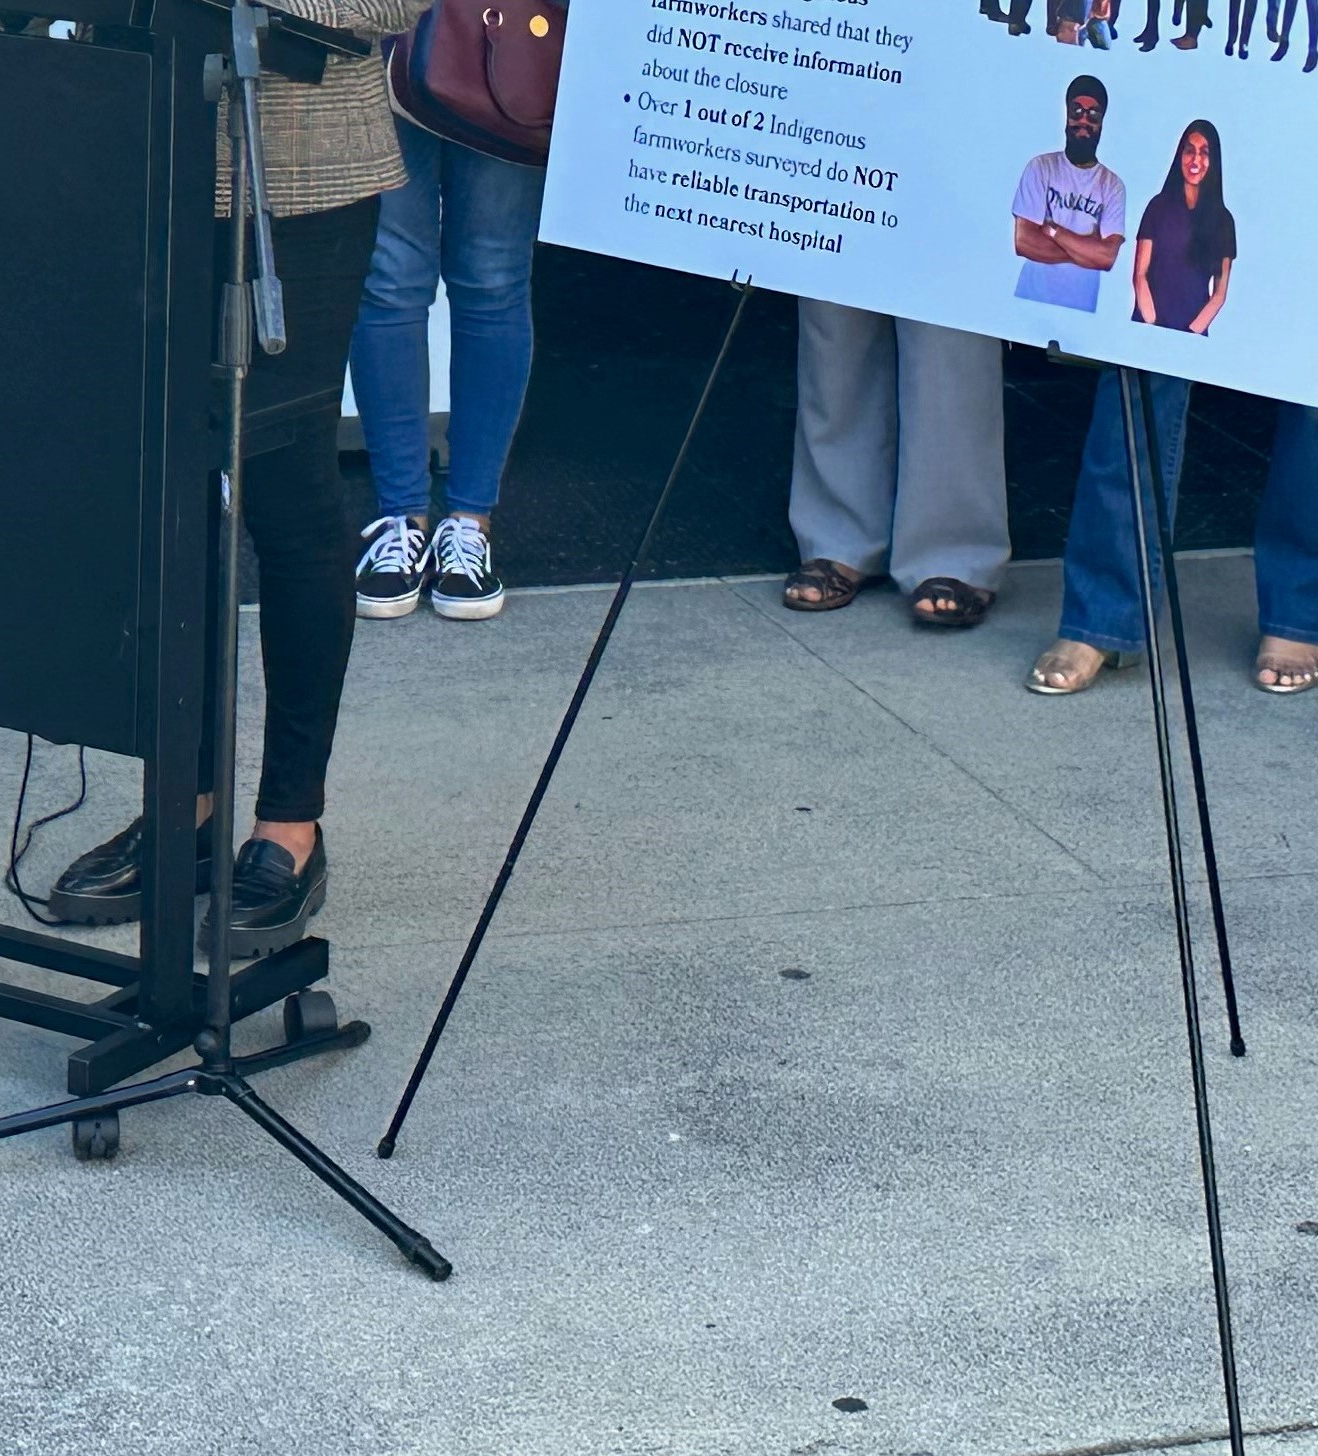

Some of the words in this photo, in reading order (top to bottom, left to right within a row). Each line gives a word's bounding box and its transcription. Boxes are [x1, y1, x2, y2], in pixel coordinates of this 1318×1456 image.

[647, 24, 673, 45] did
[677, 28, 721, 53] NOT
[724, 42, 789, 64] receive
[793, 48, 903, 84] information
[772, 10, 831, 36] shared
[836, 22, 869, 43] that
[876, 26, 913, 54] they
[641, 58, 689, 83] about
[694, 67, 721, 88] the
[725, 72, 788, 100] closure
[638, 91, 679, 115] Over
[684, 99, 691, 119] 1
[698, 106, 727, 125] out
[731, 110, 752, 129] of
[753, 112, 764, 131] 2
[770, 114, 866, 150] Indigenous
[633, 125, 741, 162] farmworkers
[745, 151, 822, 178] surveyed
[827, 161, 849, 182] do
[853, 165, 898, 191] NOT
[624, 193, 650, 214] the
[655, 202, 693, 224] next
[697, 211, 764, 239] nearest
[769, 221, 843, 254] hospital
[628, 159, 667, 183] have
[672, 170, 739, 197] reliable
[744, 184, 875, 224] transportation
[882, 211, 898, 228] to
